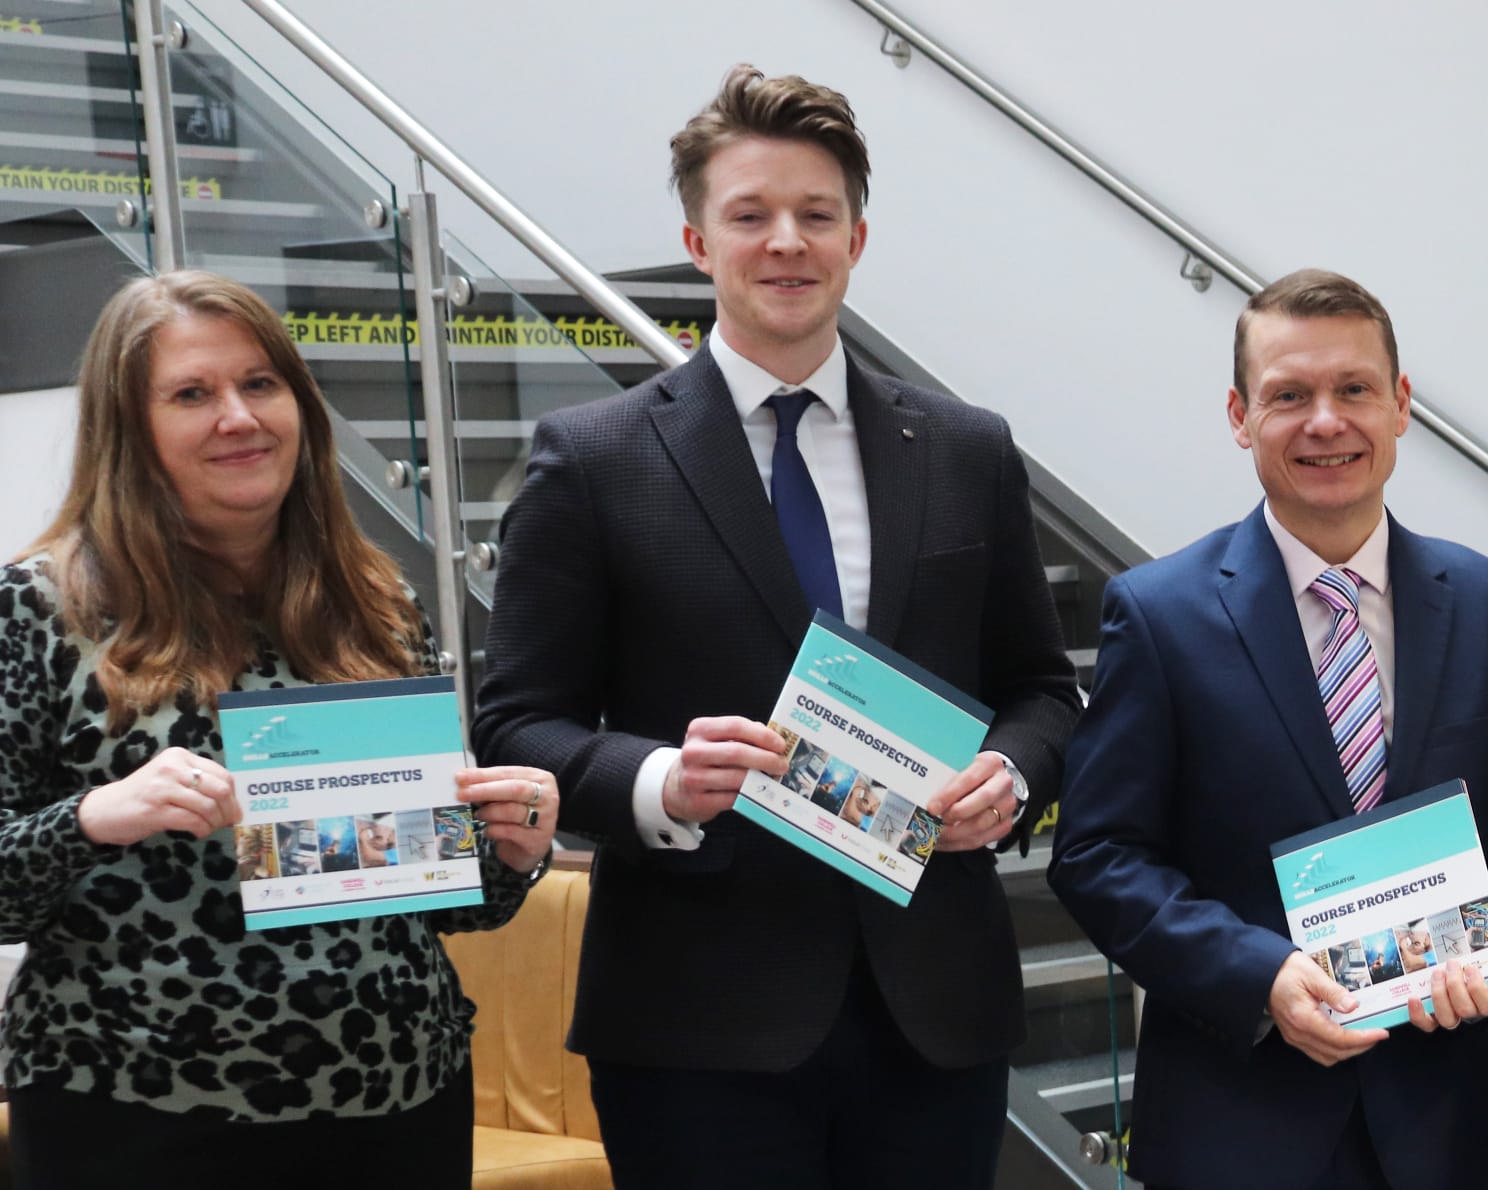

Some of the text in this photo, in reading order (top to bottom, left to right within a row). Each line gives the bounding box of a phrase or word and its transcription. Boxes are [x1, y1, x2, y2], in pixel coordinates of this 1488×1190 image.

[0, 173, 43, 190] TAIN
[46, 176, 99, 193] YOUR
[314, 324, 362, 343] LEFT
[369, 326, 416, 344] AND
[522, 327, 577, 346] YOUR
[581, 328, 635, 347] DISTA
[790, 707, 822, 733] 2022
[796, 694, 929, 778] COURSE PROSPECTUS
[247, 768, 423, 796] COURSE PROSPECTUS
[250, 797, 289, 812] 2022
[1301, 871, 1448, 929] COURSE PROSPECTUS
[1304, 923, 1337, 944] 2022
